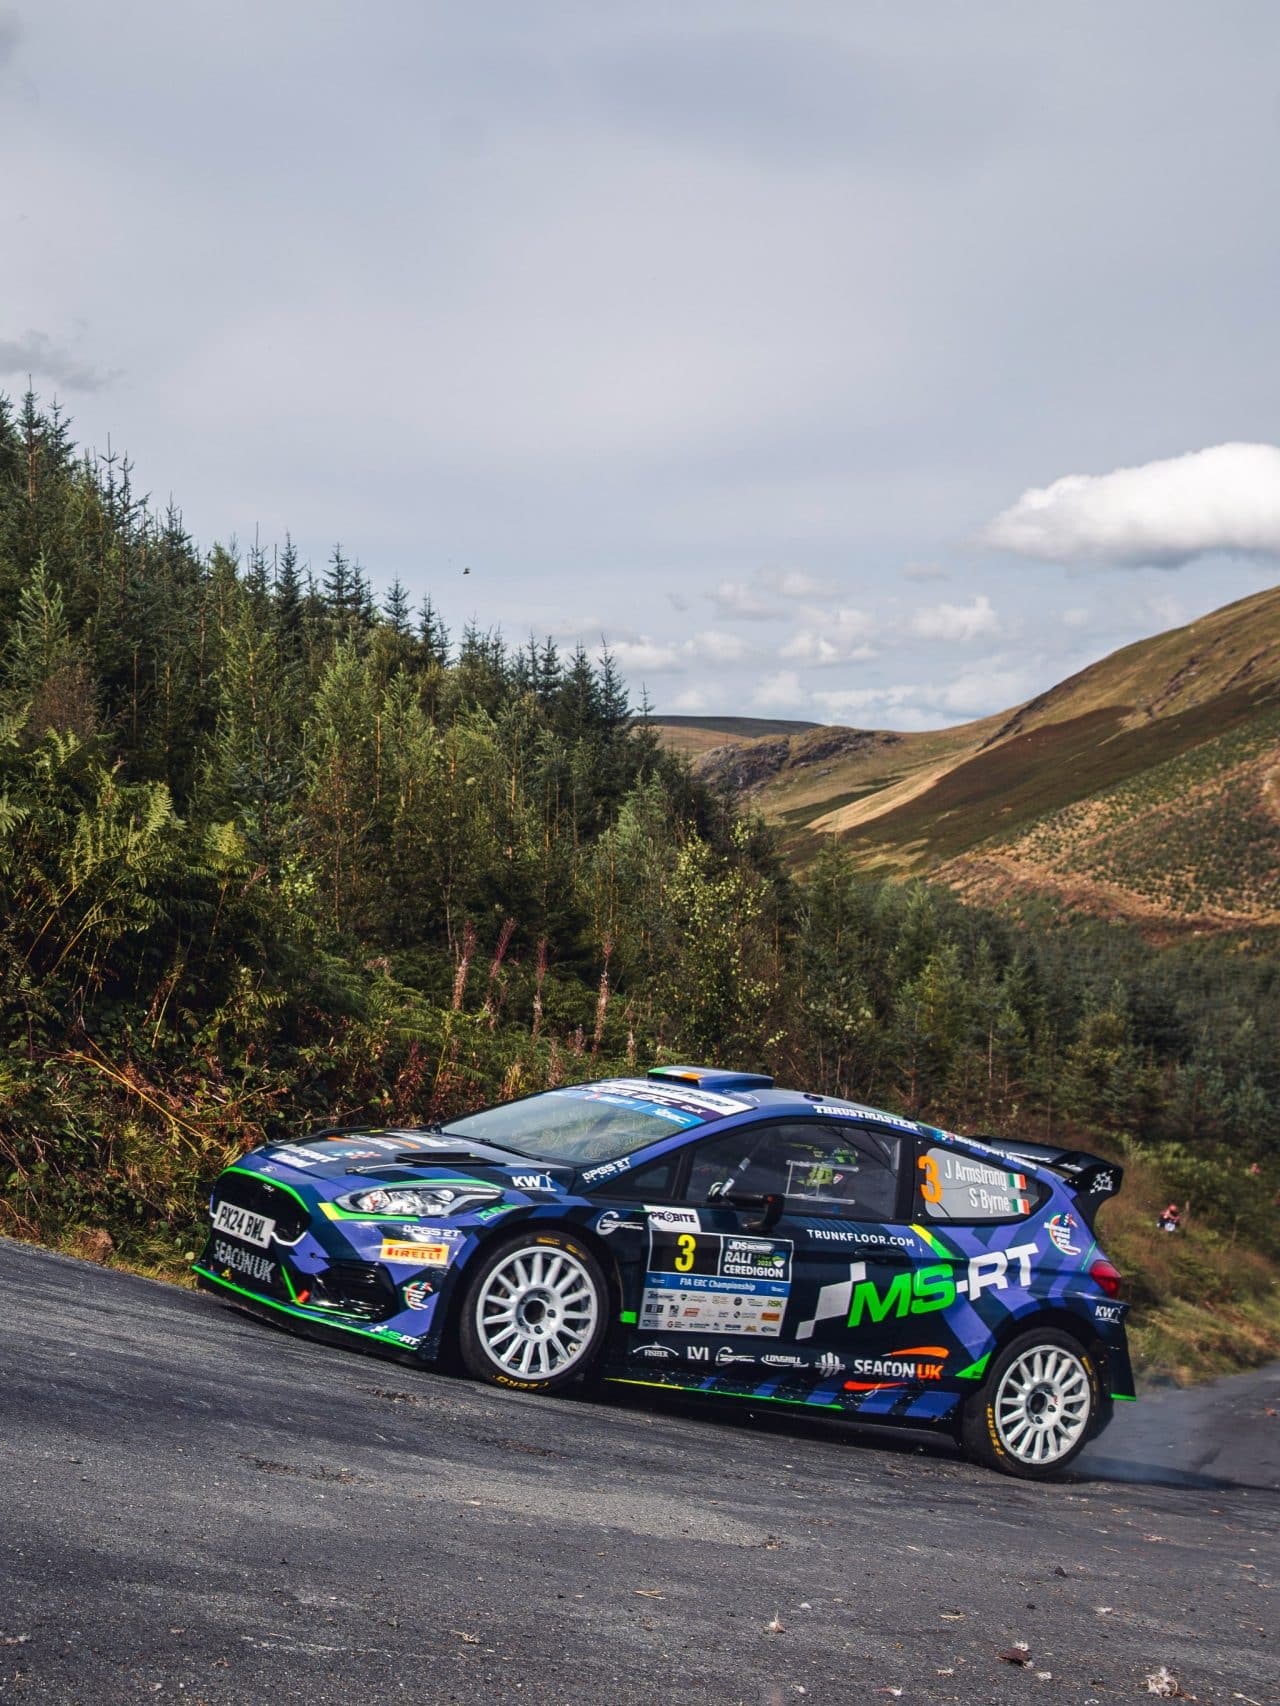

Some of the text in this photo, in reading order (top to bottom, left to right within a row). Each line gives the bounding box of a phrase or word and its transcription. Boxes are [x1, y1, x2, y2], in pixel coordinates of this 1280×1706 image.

[812, 1105, 918, 1131] THRUSTMASTER
[918, 1155, 943, 1204] 3
[945, 1160, 952, 1179] J
[955, 1160, 1008, 1191] Armstrong
[969, 1187, 1010, 1214] S Byrne
[217, 1206, 245, 1233] PX24
[649, 1210, 697, 1224] PROBITE
[806, 1229, 915, 1247] TRUNKFLOOR.COM
[387, 1247, 441, 1260] PIRELLI
[674, 1234, 697, 1272] 3
[724, 1251, 752, 1264] RALI
[723, 1264, 784, 1278] CEREDIGION
[680, 1277, 692, 1287] FIA
[708, 1280, 756, 1292] Championship
[687, 1346, 709, 1360] LVI
